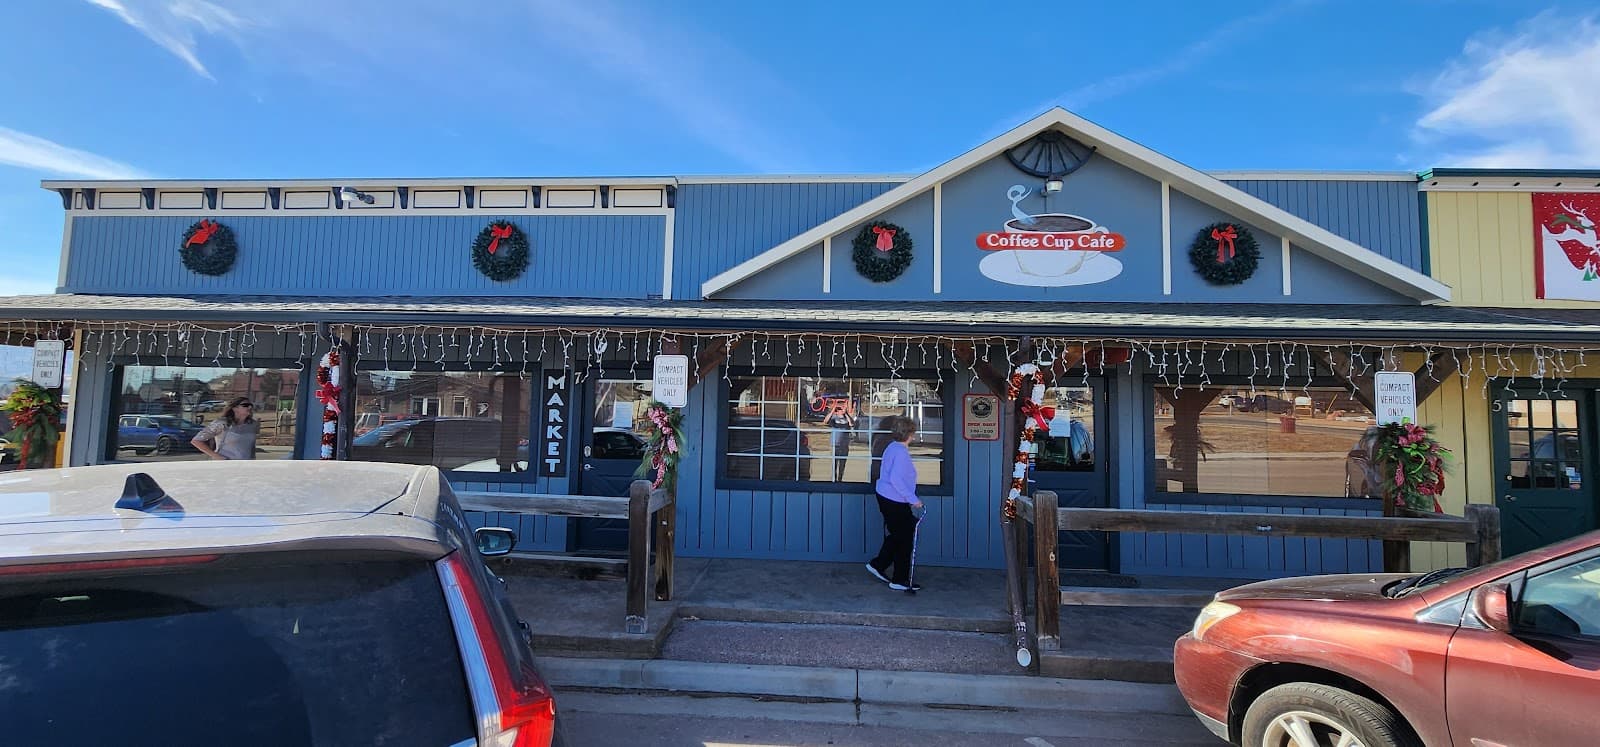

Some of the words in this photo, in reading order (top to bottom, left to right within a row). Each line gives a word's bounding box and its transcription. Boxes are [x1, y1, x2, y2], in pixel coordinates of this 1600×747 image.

[986, 234, 1039, 248] Coffee
[1042, 234, 1074, 250] Cup
[1078, 234, 1115, 248] Cafe
[657, 365, 684, 374] COMPACT
[574, 371, 582, 385] 7
[657, 377, 684, 385] VEHICLES
[1379, 383, 1410, 392] COMPACT
[662, 388, 677, 397] ONLY
[1380, 395, 1412, 404] VEHICLES
[1492, 400, 1502, 412] 5
[1387, 407, 1404, 416] ONLY
[545, 375, 566, 473] MARKET
